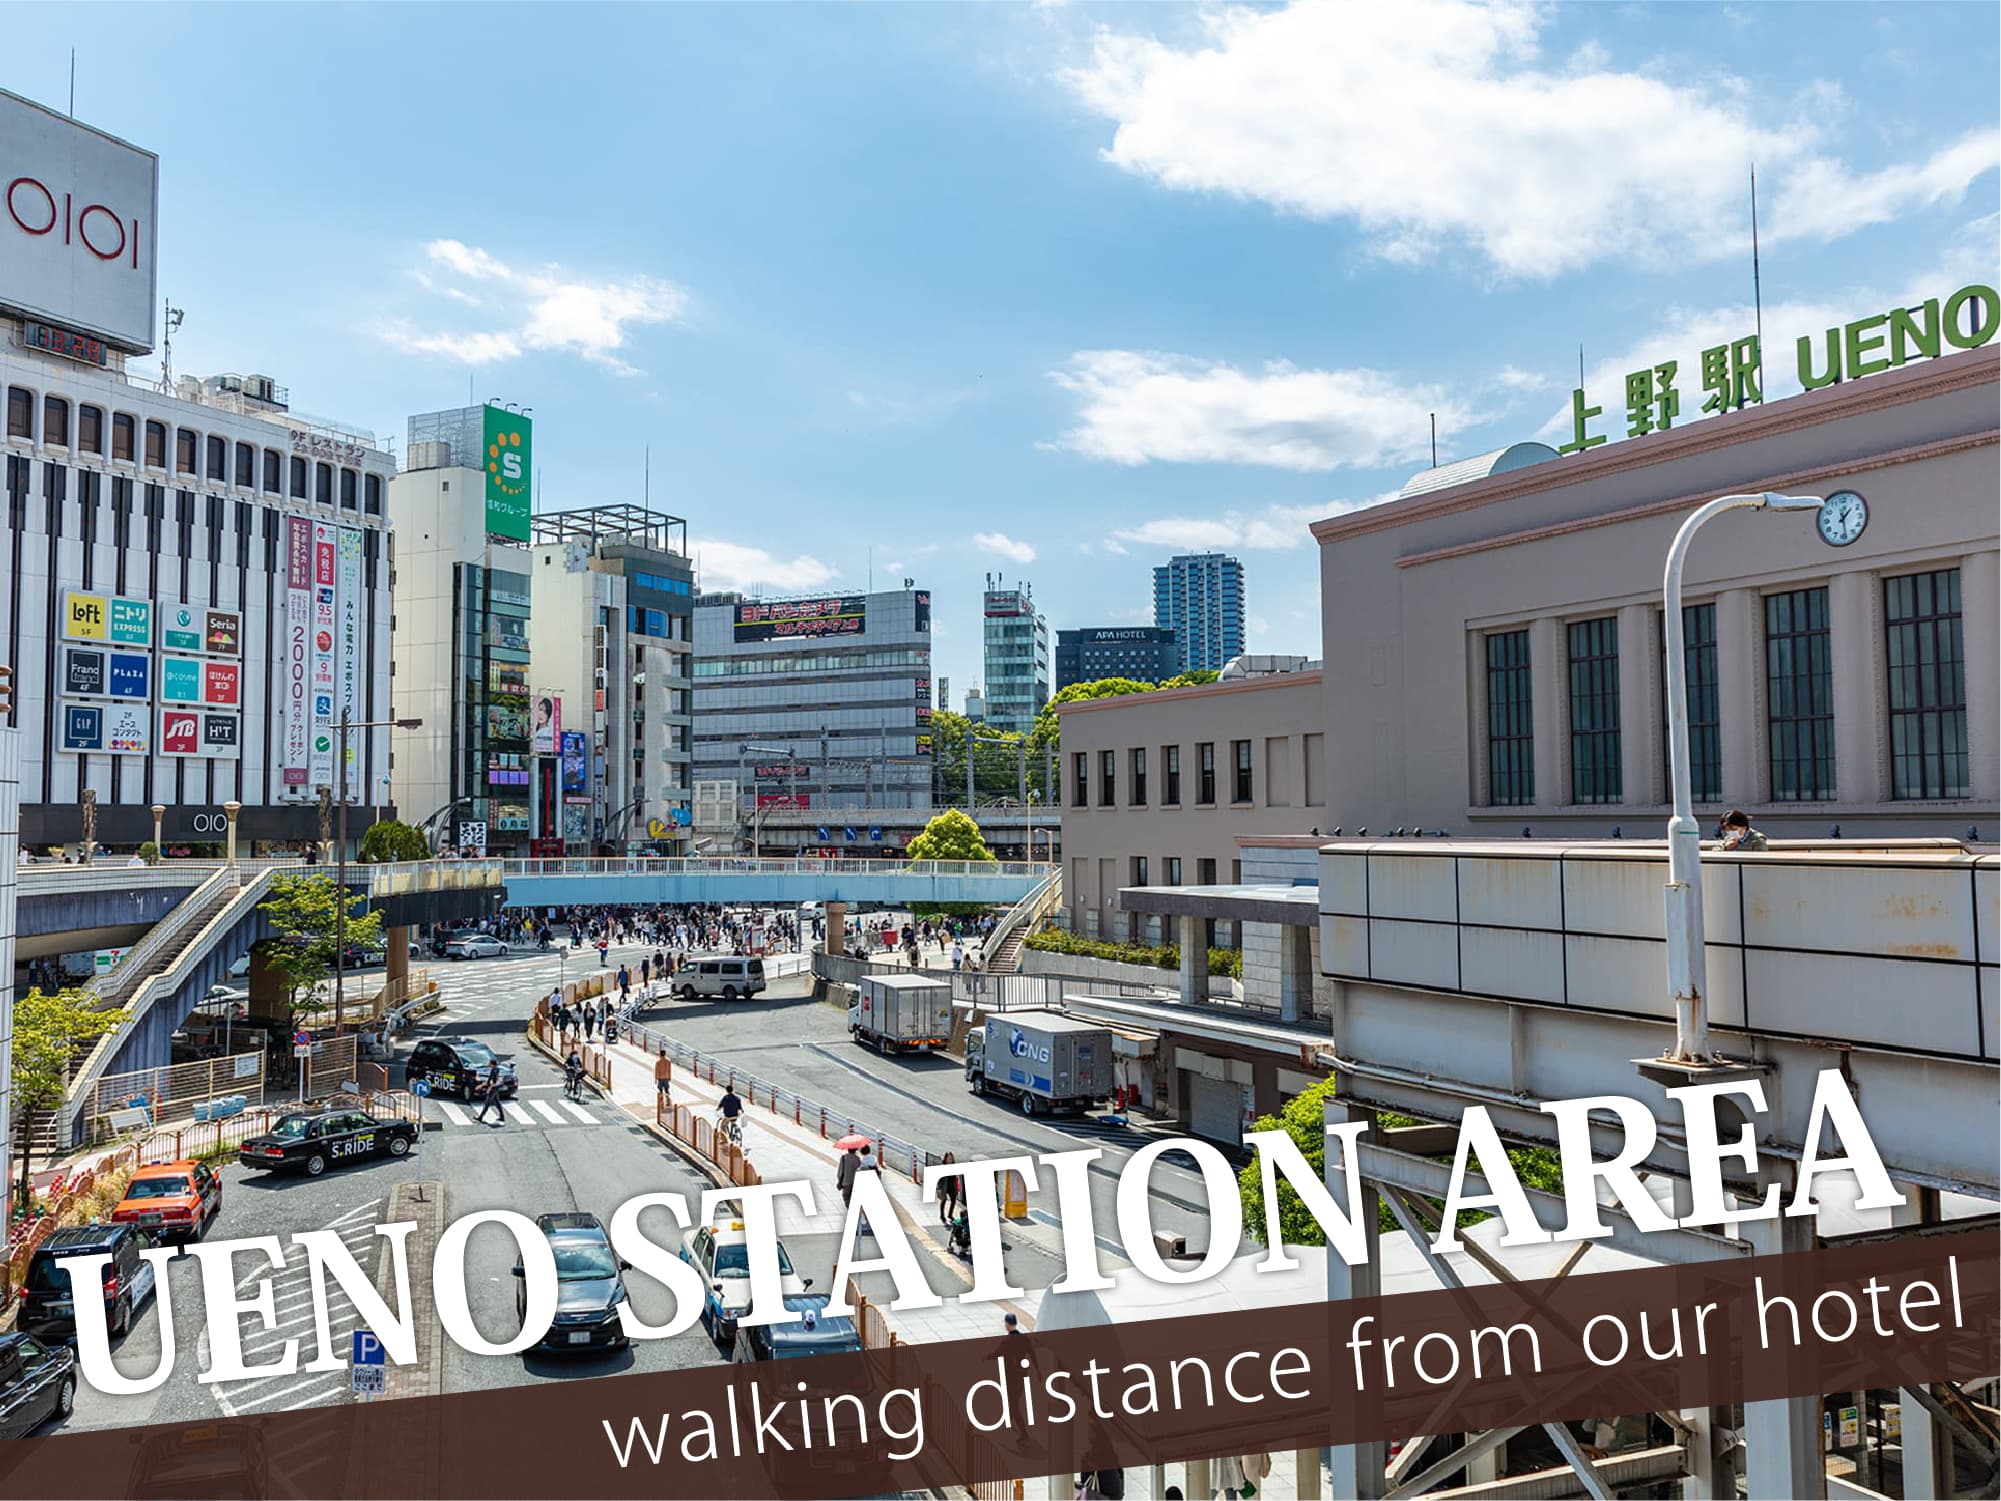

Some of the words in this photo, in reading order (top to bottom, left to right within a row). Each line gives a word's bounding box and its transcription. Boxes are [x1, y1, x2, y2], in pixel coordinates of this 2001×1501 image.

[1559, 335, 1761, 455] 上野駅
[1797, 284, 2000, 391] UENO
[114, 605, 147, 621] ニトリ
[741, 600, 842, 622] ヨドバシカメラ
[210, 617, 237, 631] Seria
[774, 618, 860, 635] マルチメディア上野
[1095, 631, 1116, 640] APA
[1115, 630, 1147, 640] HOTEL
[113, 668, 144, 678] PLAZA
[112, 727, 143, 738] コンタクト
[118, 720, 137, 728] エース
[166, 718, 196, 740] JTB
[1016, 1040, 1049, 1063] CNG
[331, 1133, 375, 1159] S.RIDE
[361, 1334, 381, 1362] P
